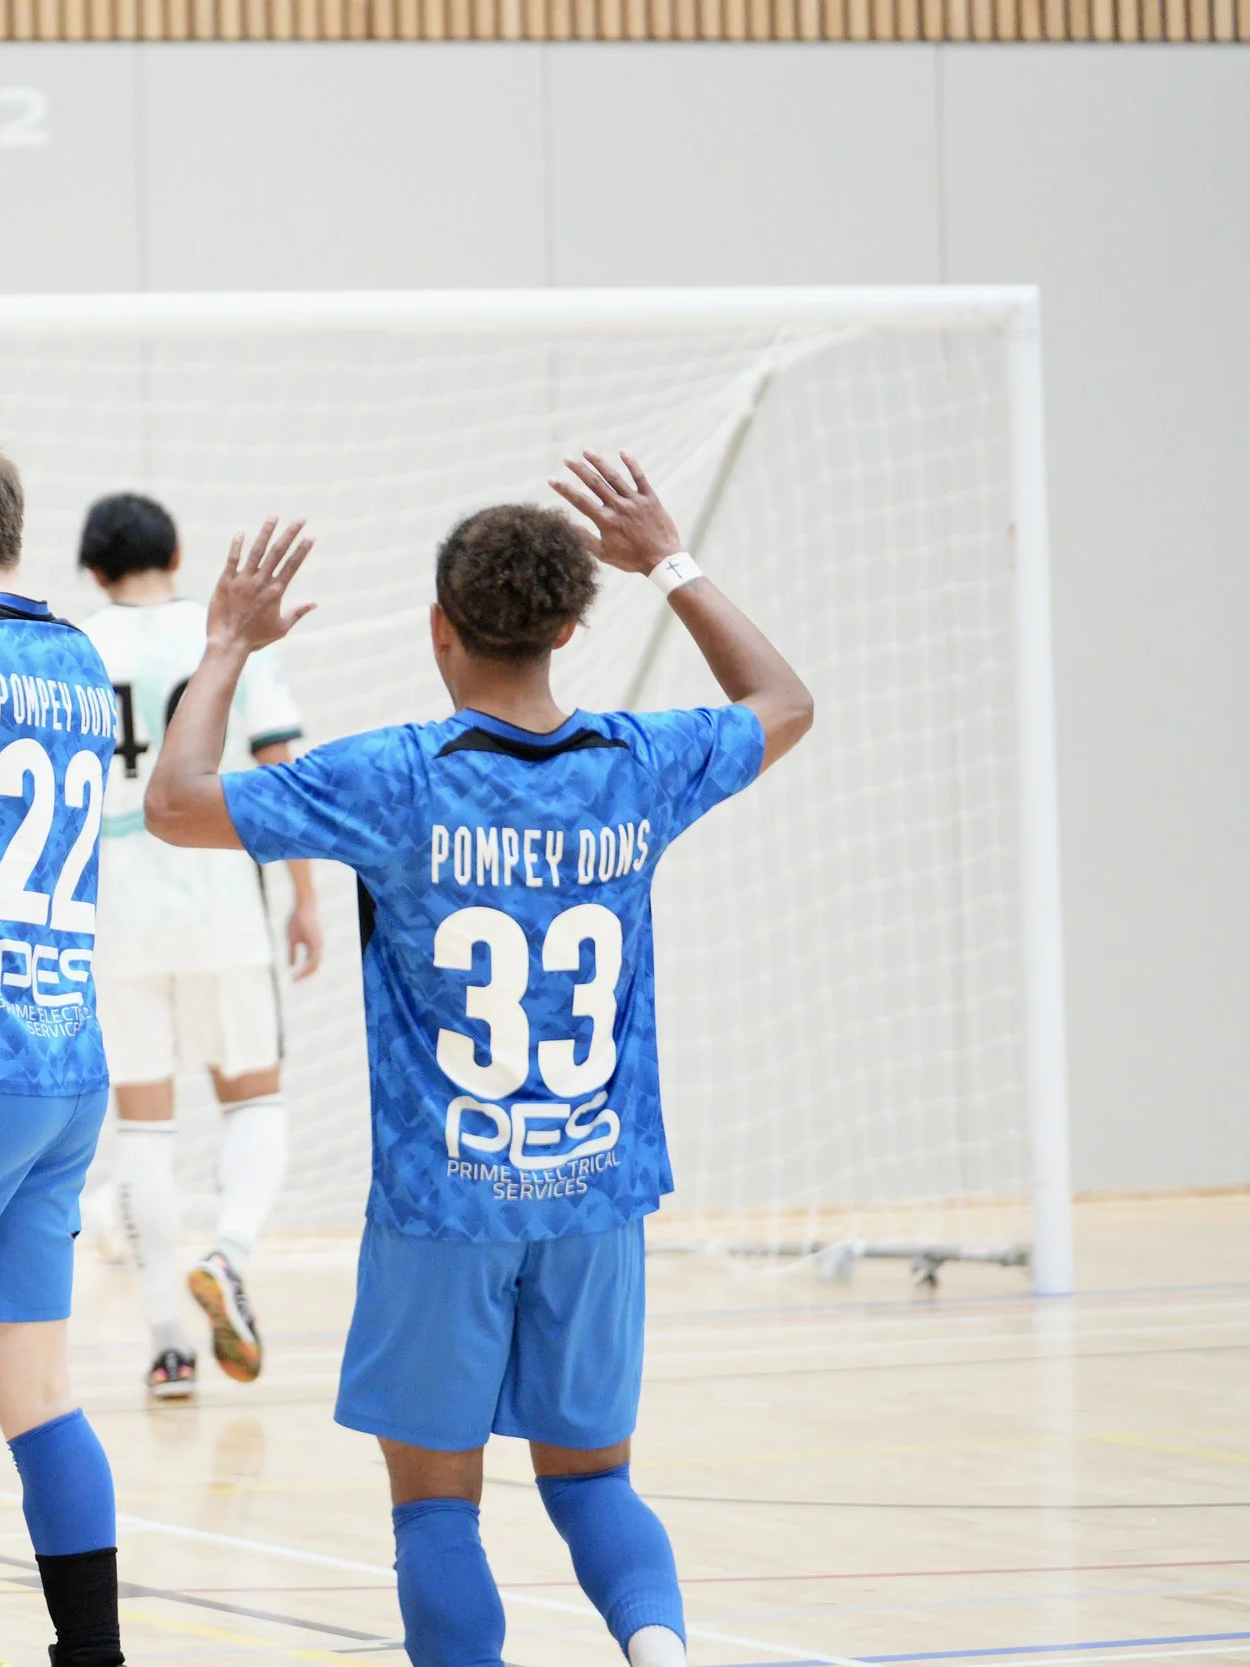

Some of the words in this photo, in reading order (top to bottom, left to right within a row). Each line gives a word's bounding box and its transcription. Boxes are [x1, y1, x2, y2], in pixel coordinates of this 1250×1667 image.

[431, 824, 563, 887] POMPEY
[578, 819, 650, 884] DONS
[433, 903, 622, 1100] 33
[445, 1091, 620, 1170] PES
[447, 1160, 512, 1182] PRIME
[519, 1150, 621, 1184] ELECTRICAL
[493, 1176, 588, 1200] SERVICES
